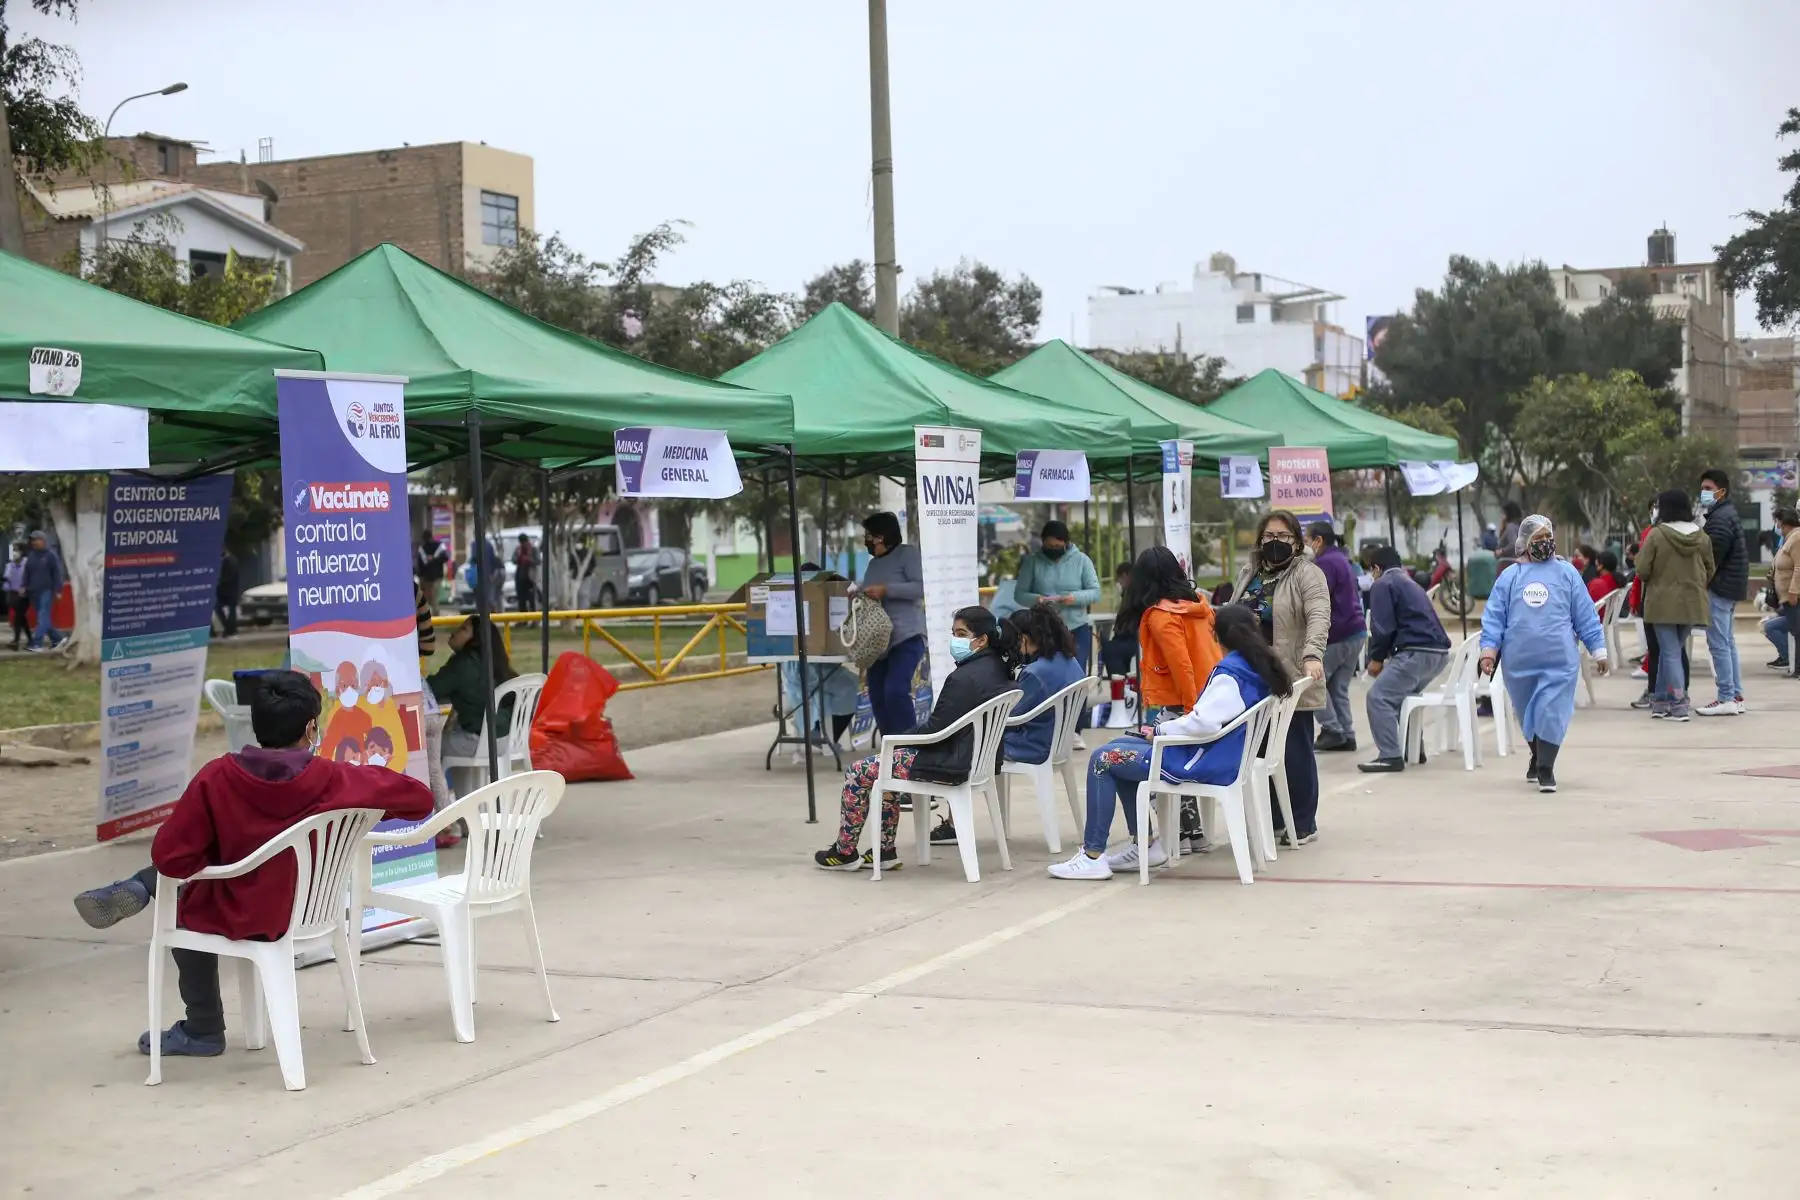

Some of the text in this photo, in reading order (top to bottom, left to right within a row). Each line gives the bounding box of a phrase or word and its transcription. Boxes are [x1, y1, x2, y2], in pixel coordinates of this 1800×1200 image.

[31, 349, 79, 367] STAND 26
[373, 402, 394, 412] JUNTOS
[368, 412, 400, 423] VENCEREMOS
[369, 425, 380, 438] AL
[616, 439, 644, 454] MINSA
[662, 445, 709, 461] MEDICINA
[661, 468, 709, 482] GENERAL
[1039, 468, 1075, 480] FARMACIA
[1284, 474, 1292, 484] LA
[1294, 473, 1328, 484] VIRUELA
[114, 486, 187, 502] CENTRO DE
[310, 484, 389, 511] Vacúnate
[922, 475, 975, 505] MINSA
[1277, 487, 1323, 499] DEL MONO
[113, 506, 221, 525] OXIGENOTERAPIA
[112, 530, 178, 546] TEMPORAL
[295, 518, 366, 544] contra la
[296, 549, 381, 577] influenza y
[298, 579, 381, 607] neumonía
